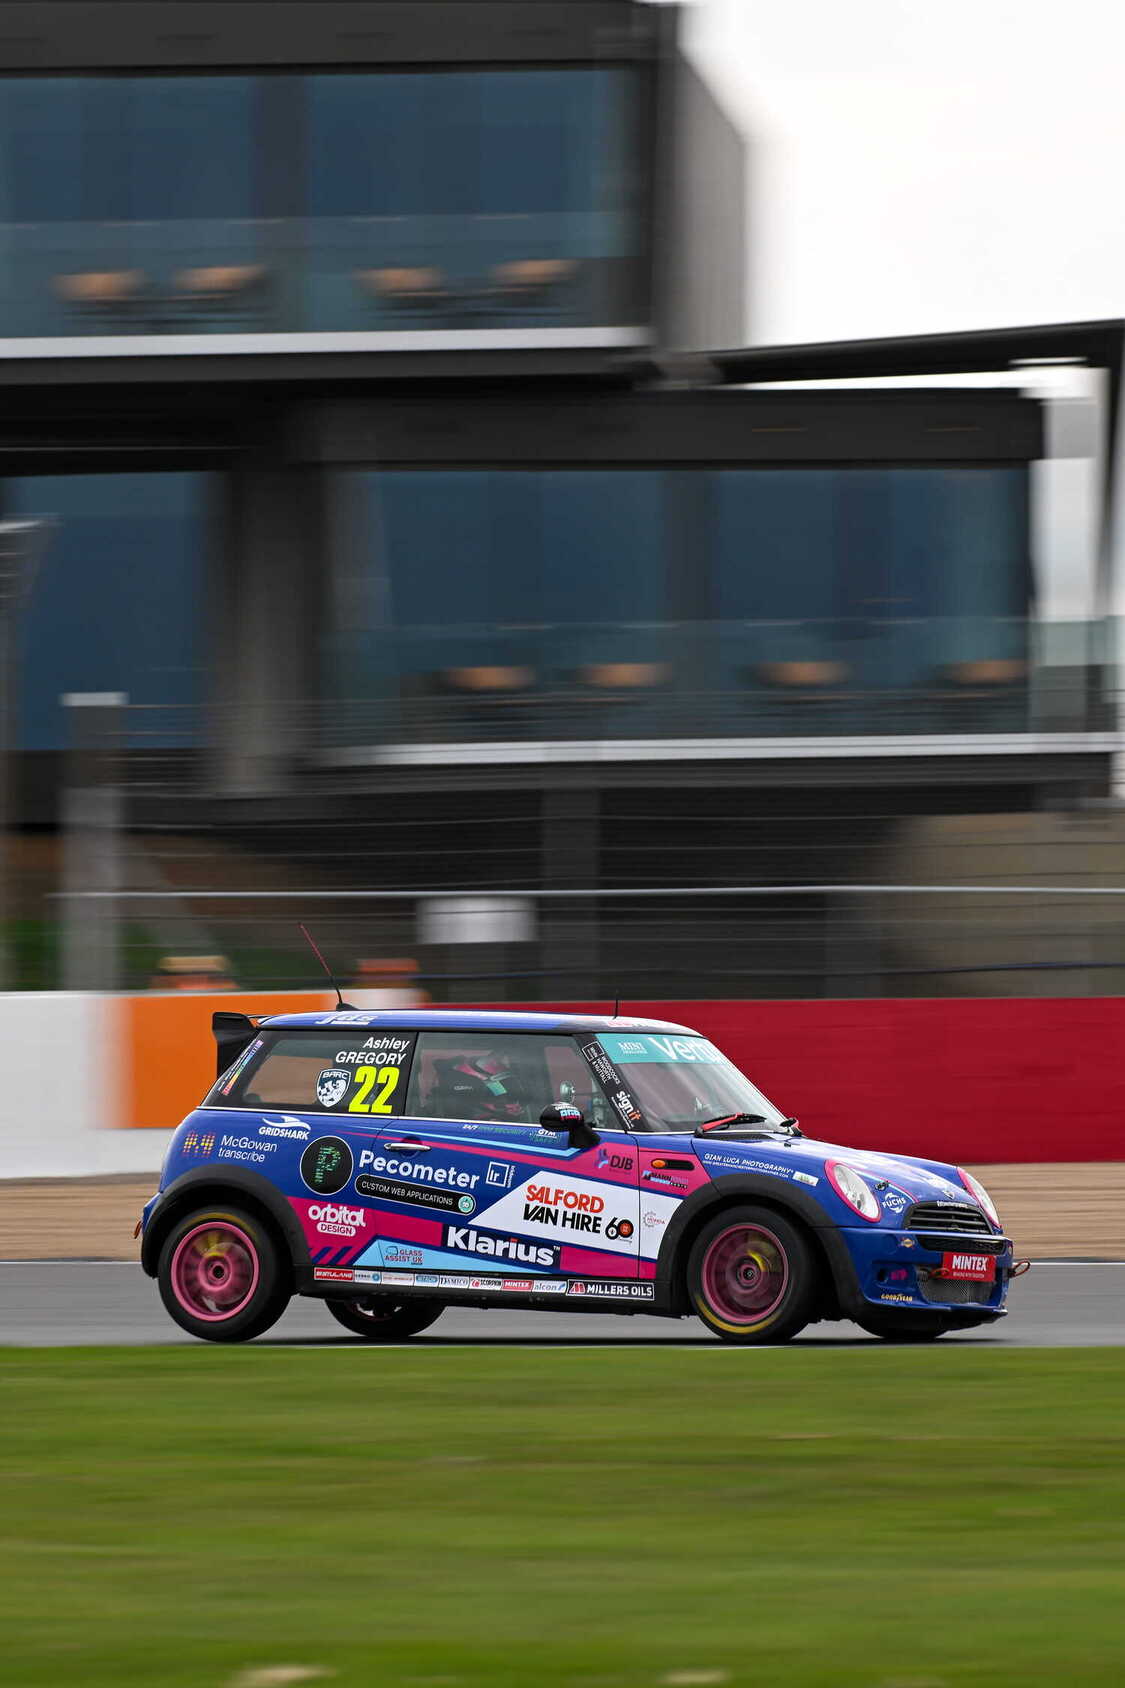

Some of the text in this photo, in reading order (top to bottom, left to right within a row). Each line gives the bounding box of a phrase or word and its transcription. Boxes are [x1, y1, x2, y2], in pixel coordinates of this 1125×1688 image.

[363, 1036, 410, 1052] Ashley
[335, 1051, 406, 1065] GREGORY
[323, 1071, 348, 1080] BARC
[349, 1065, 399, 1114] 22
[258, 1126, 309, 1141] GRIDSHARK
[221, 1135, 278, 1153] McGowan
[218, 1147, 265, 1162] transcribe
[610, 1155, 633, 1170] DJB
[359, 1149, 480, 1189] Pecometer
[361, 1181, 390, 1193] CUSTOM
[391, 1186, 406, 1197] WEB
[406, 1190, 453, 1205] APPLICATIONS
[526, 1184, 604, 1213] SALFORD
[882, 1197, 906, 1208] FUCHS
[308, 1204, 366, 1227] orbital
[523, 1203, 602, 1234] VAN HIRE
[320, 1223, 353, 1235] DESIGN
[447, 1226, 554, 1266] Klarius
[952, 1255, 989, 1271] MINTEX
[587, 1284, 652, 1296] MILLERS OILS
